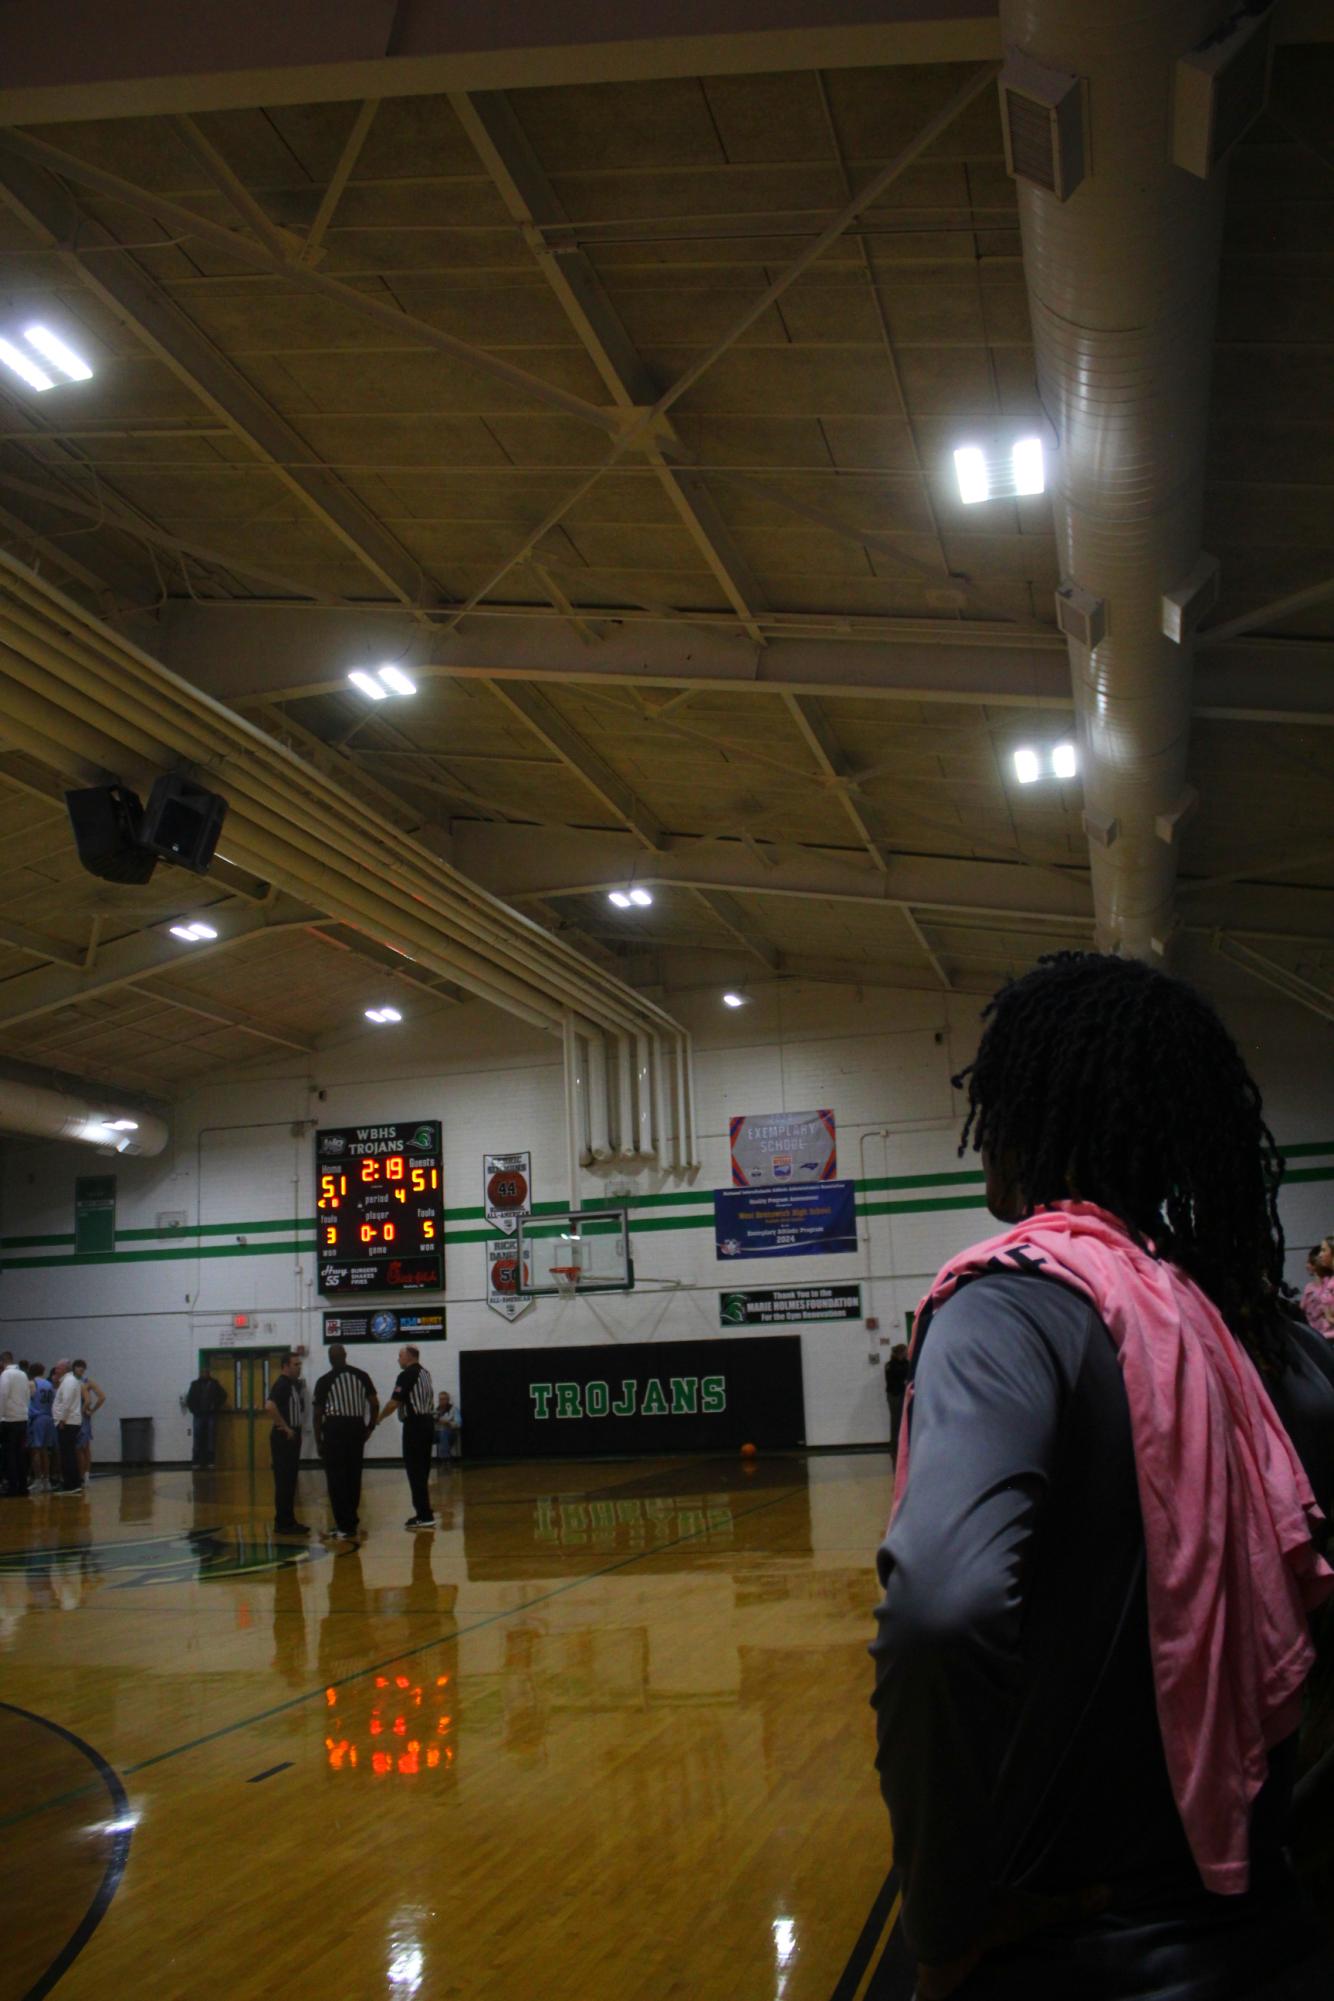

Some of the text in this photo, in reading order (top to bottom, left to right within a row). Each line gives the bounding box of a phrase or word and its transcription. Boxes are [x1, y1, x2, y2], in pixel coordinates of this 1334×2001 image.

[356, 1126, 396, 1139] WBHS
[748, 1123, 816, 1139] EXEMPLARY
[348, 1140, 404, 1155] TROJANS
[760, 1139, 806, 1152] SCHOOL
[362, 1157, 403, 1181] 2:19
[322, 1175, 346, 1197] 51
[412, 1169, 437, 1191] 51
[395, 1188, 405, 1203] 4
[499, 1182, 516, 1195] 44
[327, 1227, 336, 1244] 3
[384, 1223, 394, 1240] 0
[423, 1221, 434, 1238] 5
[773, 1291, 796, 1300] Thank
[746, 1297, 859, 1312] MARIE HOLMES FOUNDATION
[529, 1376, 727, 1419] TROJANS
